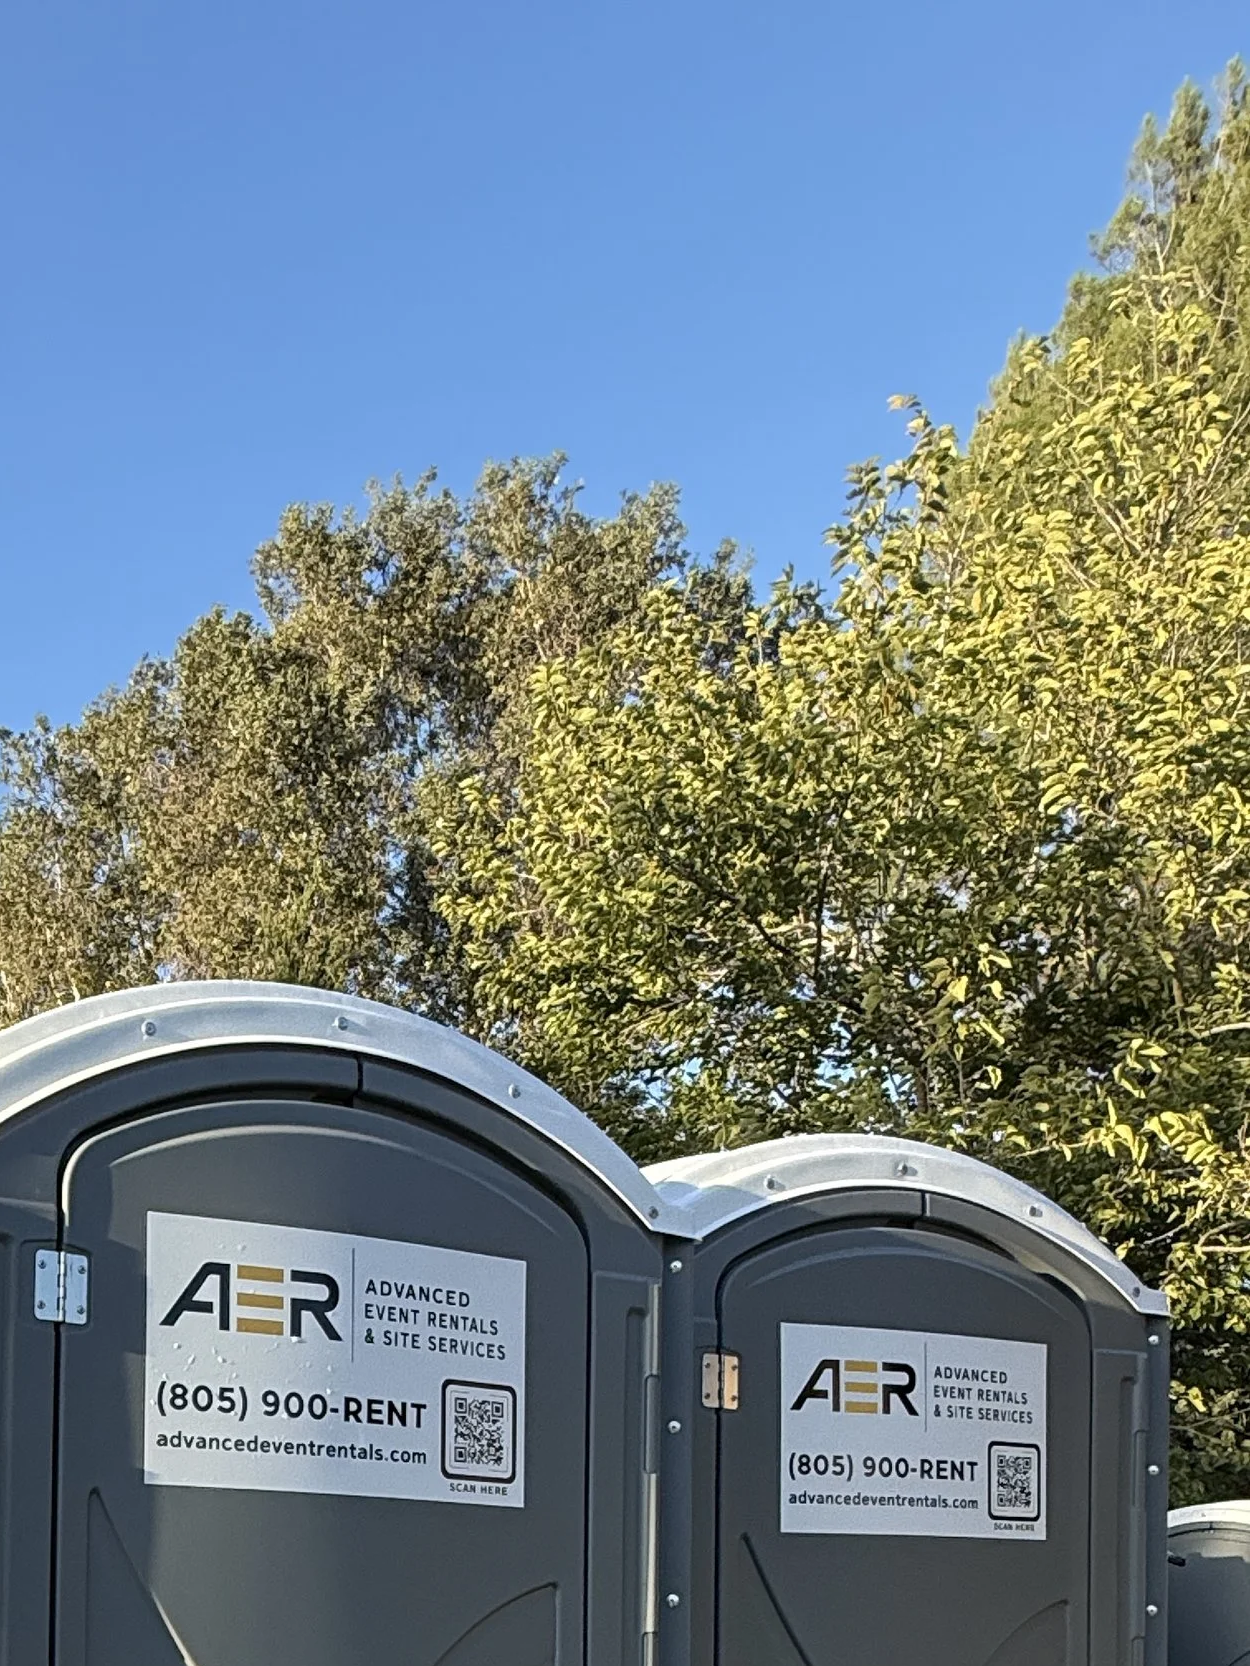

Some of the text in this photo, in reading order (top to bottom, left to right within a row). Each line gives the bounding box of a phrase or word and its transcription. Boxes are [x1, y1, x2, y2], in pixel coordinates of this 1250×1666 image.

[159, 1261, 343, 1342] AER
[365, 1279, 470, 1308] ADVANCED
[364, 1303, 499, 1336] EVENT RENTALS
[364, 1328, 506, 1361] & SITE SERVICES
[790, 1359, 919, 1416] AER
[934, 1366, 1008, 1384] ADVANCED
[156, 1381, 427, 1428] (805) 900-RENT
[934, 1387, 1028, 1405] EVENT RENTALS
[934, 1404, 1033, 1424] & SITE SERVICES
[156, 1431, 427, 1465] advancedeventrentals.com
[788, 1452, 978, 1482] (805) 900-RENT
[449, 1483, 508, 1496] SCAN HERE
[788, 1491, 979, 1509] advancedeventrentals.com
